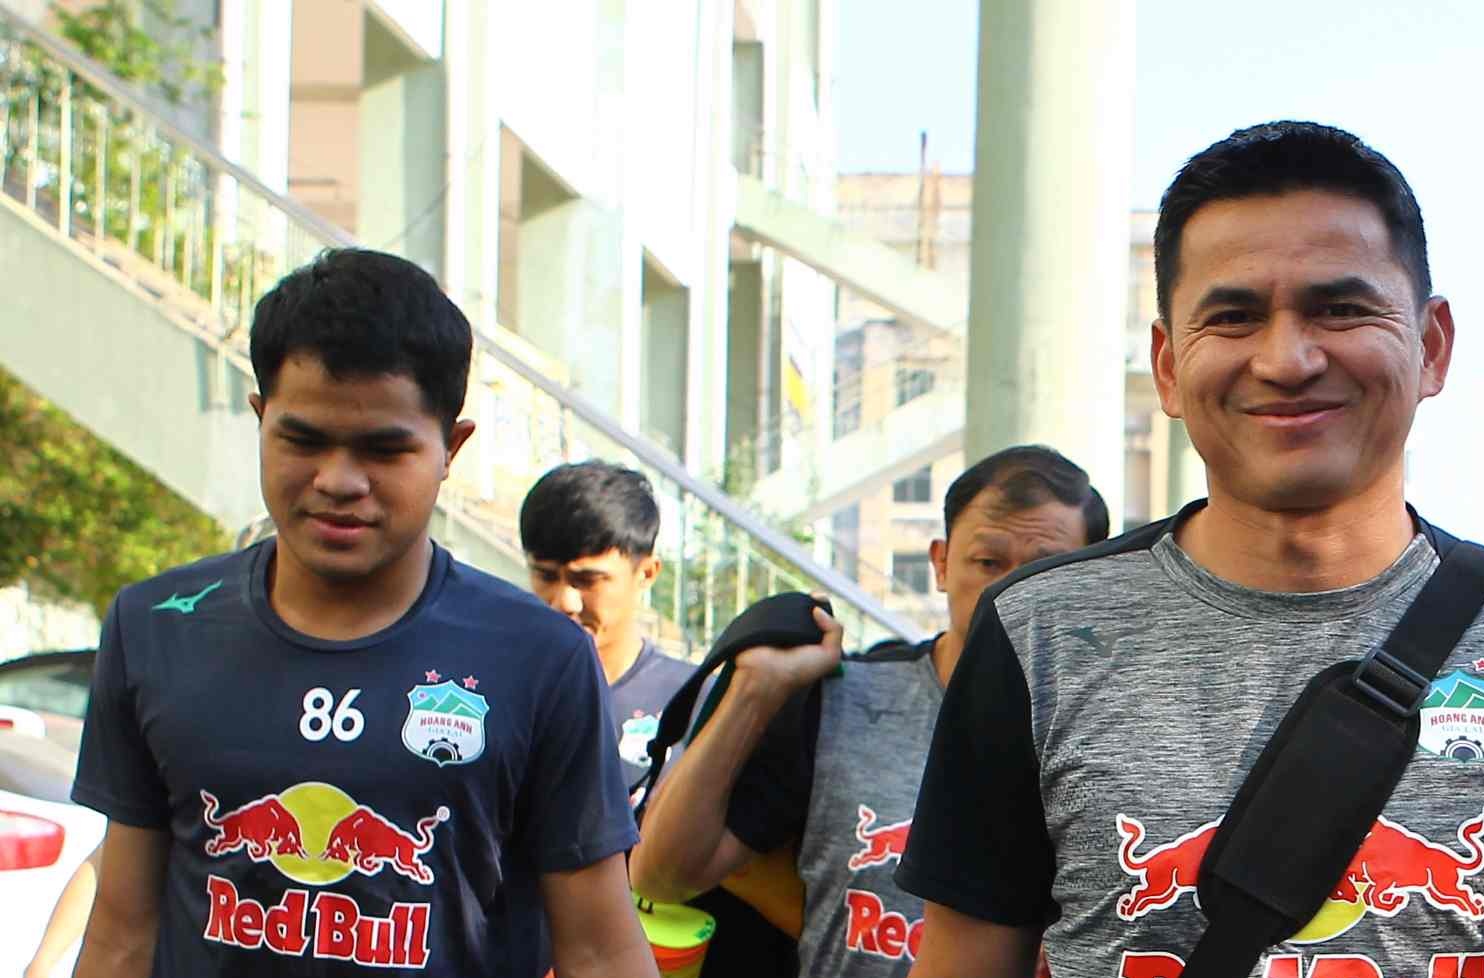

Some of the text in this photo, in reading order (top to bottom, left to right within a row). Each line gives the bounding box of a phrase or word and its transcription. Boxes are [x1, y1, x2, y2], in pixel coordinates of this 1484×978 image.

[299, 687, 365, 742] 86
[453, 719, 473, 735] ANH
[1430, 713, 1468, 727] HOANG
[203, 874, 431, 969] Red Bull
